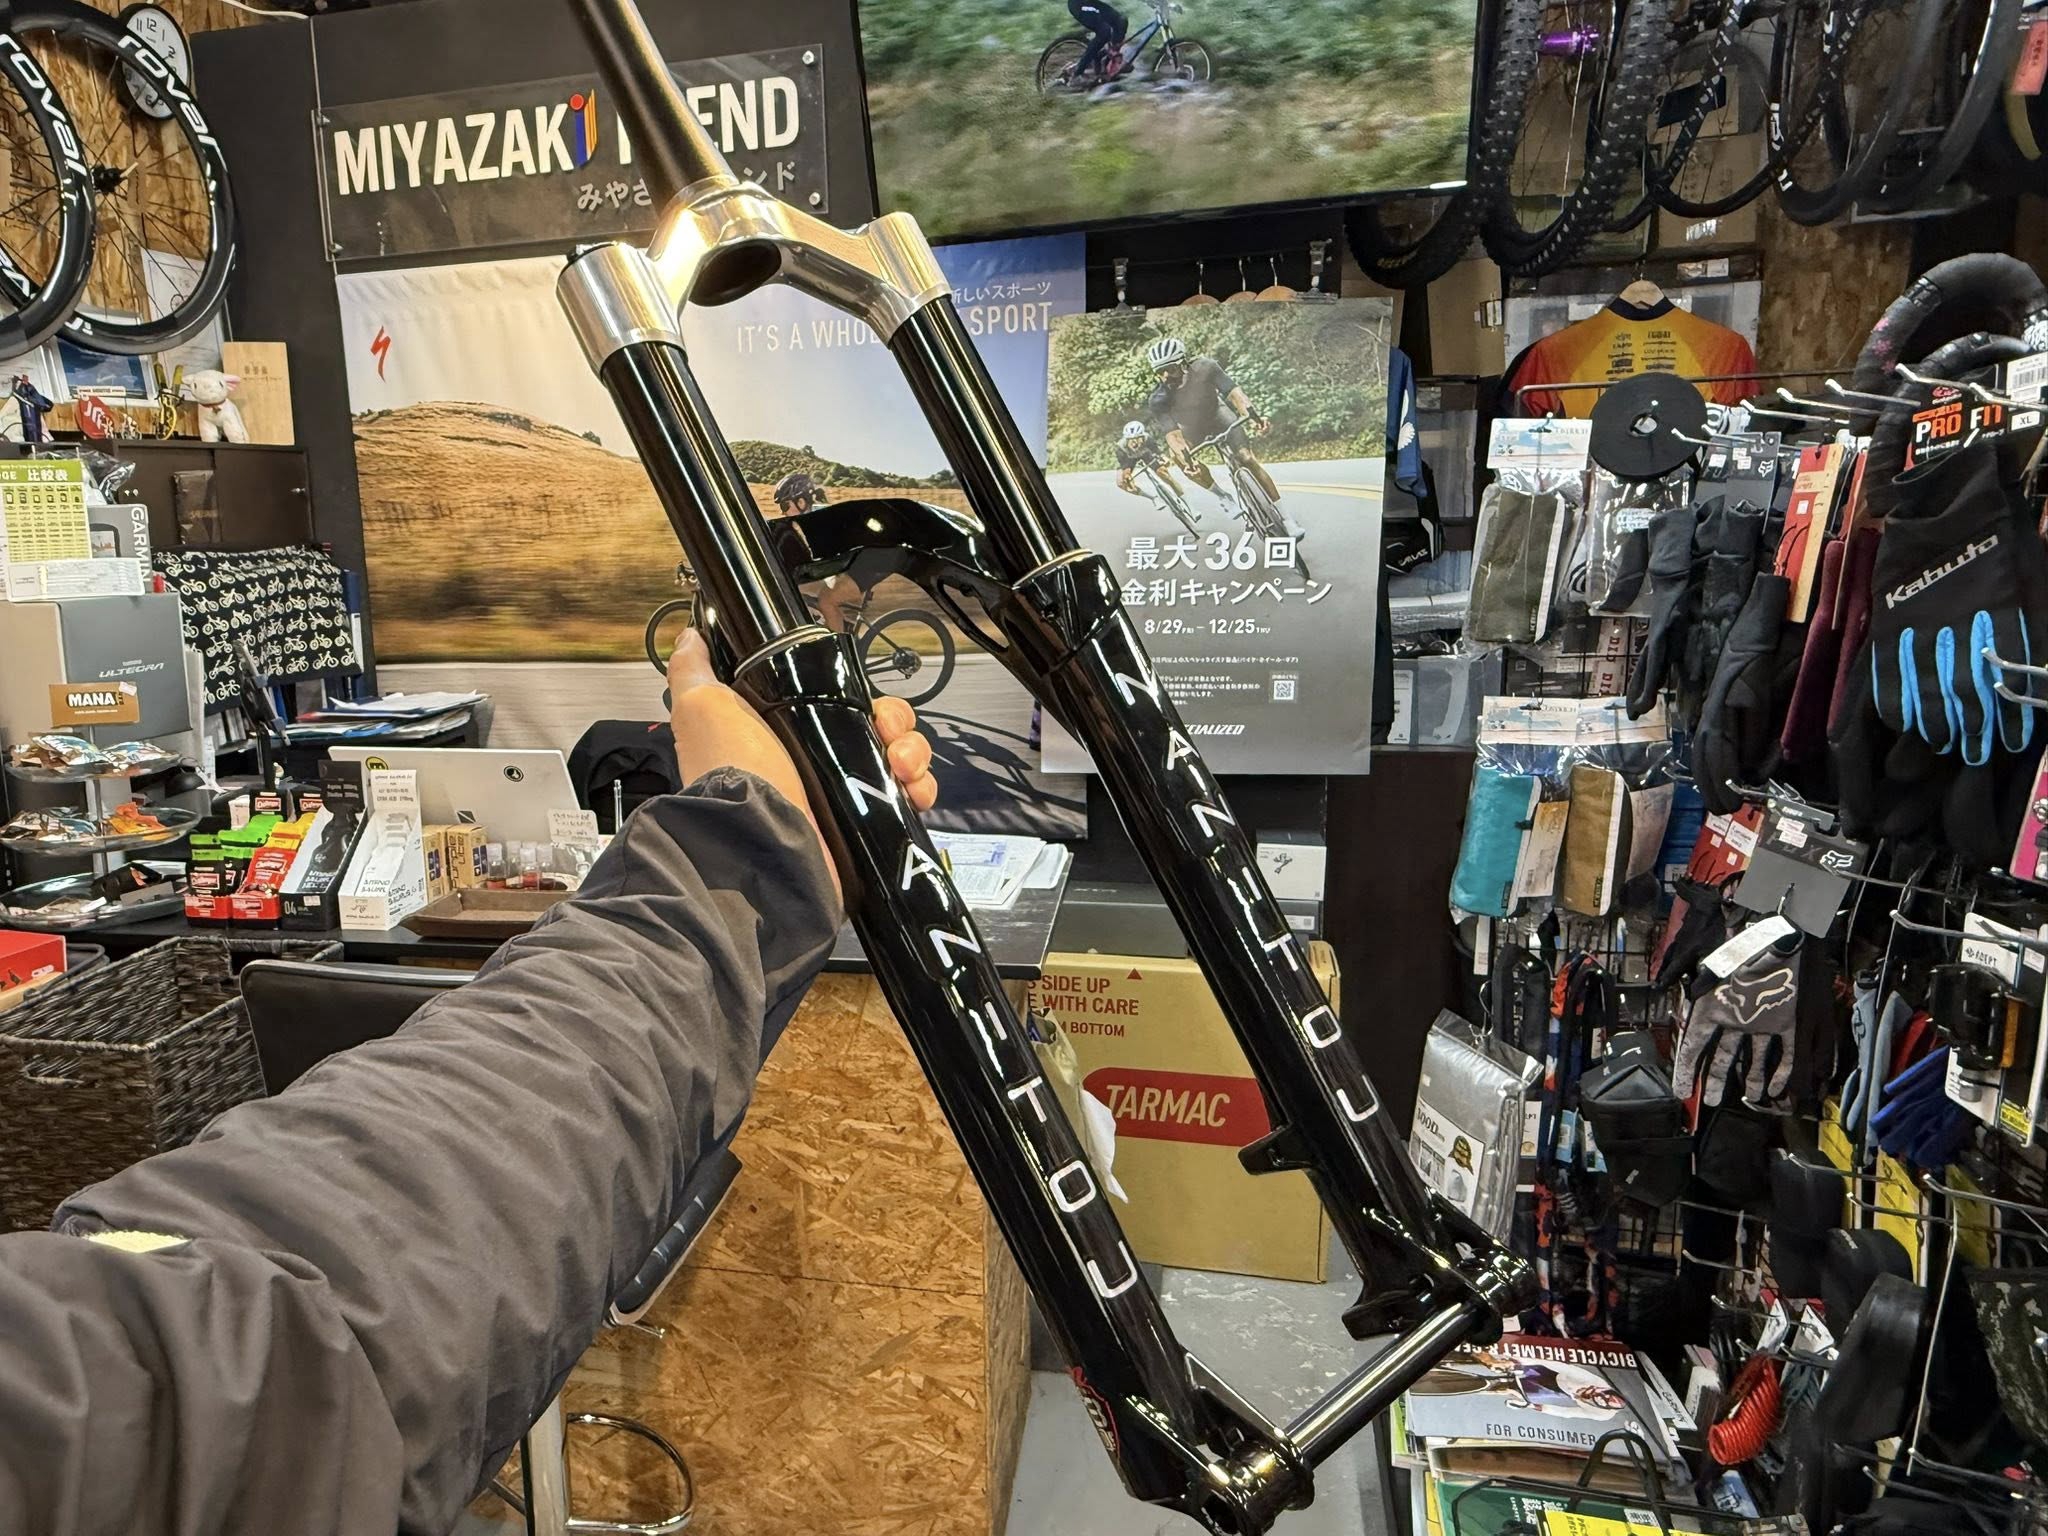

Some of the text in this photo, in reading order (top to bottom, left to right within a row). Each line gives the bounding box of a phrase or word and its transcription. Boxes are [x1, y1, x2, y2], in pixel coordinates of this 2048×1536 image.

[737, 325, 779, 353] IT'S
[789, 327, 803, 351] A
[970, 302, 1052, 336] SPORT
[1915, 404, 2003, 443] PRO FIT
[2019, 416, 2032, 426] XL
[1885, 535, 1998, 610] Kabuto
[1121, 578, 1333, 607] 金利キャンペーン
[99, 662, 164, 678] ULTEGRA
[68, 692, 116, 707] MANA
[1042, 975, 1110, 993] SIDE UP
[1042, 994, 1087, 1013] WITH
[1092, 997, 1139, 1016] CARE
[1070, 1022, 1124, 1037] BOTTOM
[1106, 1084, 1230, 1127] TARMAC
[1502, 1343, 1566, 1364] HELMET
[1567, 1348, 1638, 1368] BICYCLE
[1486, 1423, 1512, 1438] FOR
